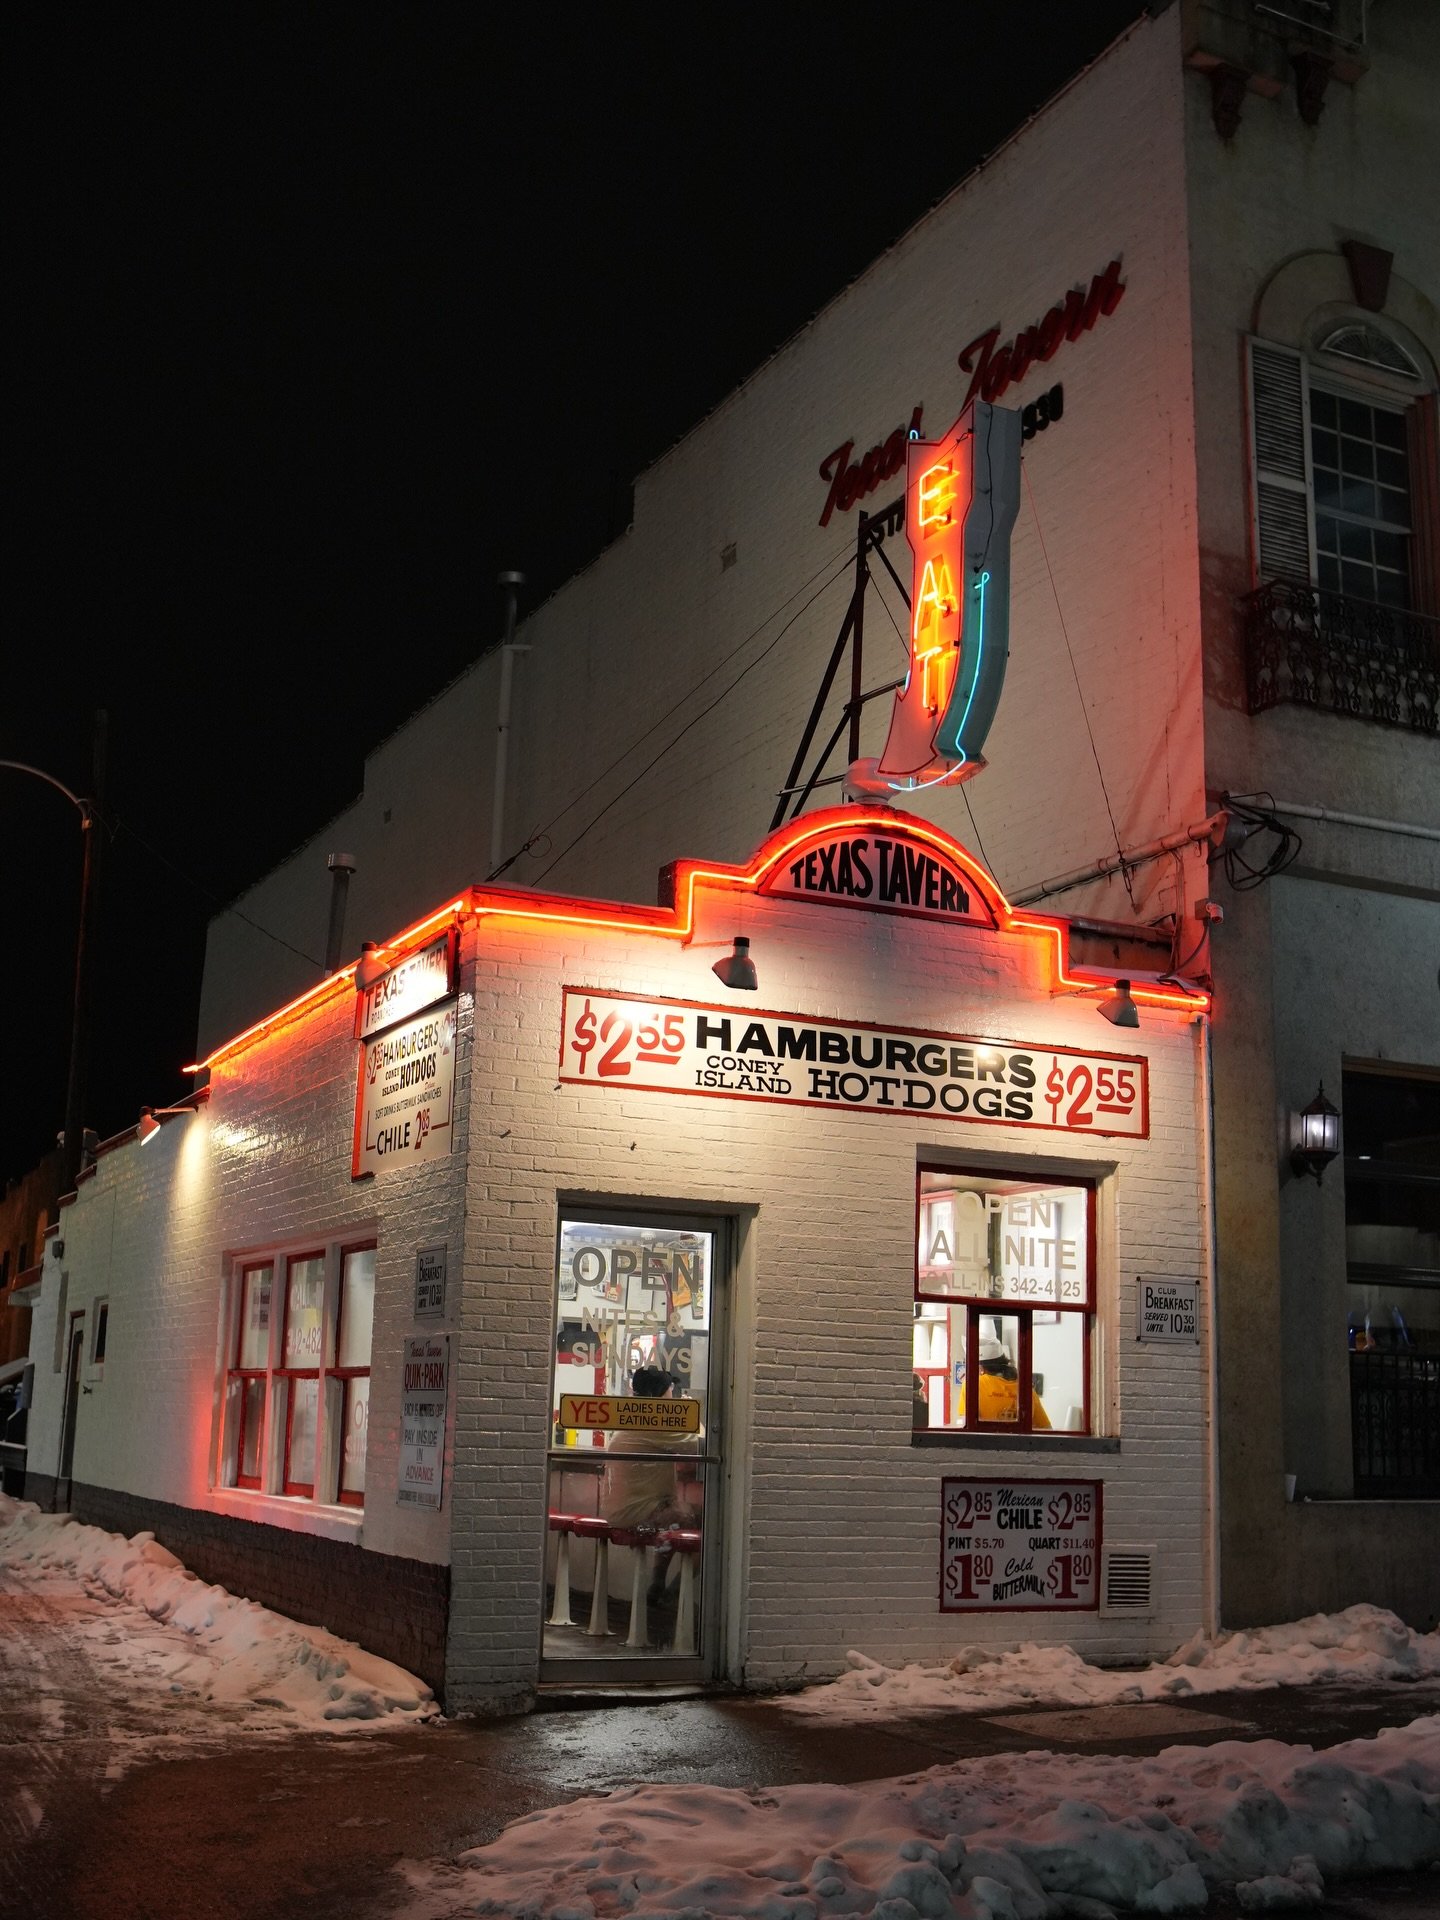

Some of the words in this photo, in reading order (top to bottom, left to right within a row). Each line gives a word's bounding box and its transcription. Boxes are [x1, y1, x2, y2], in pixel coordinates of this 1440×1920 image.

[913, 461, 960, 712] EAT
[790, 838, 873, 898] TEXAS
[875, 839, 970, 914] TAVERN
[365, 969, 405, 1028] TEXAS
[383, 1021, 439, 1068] HAMBURGERS
[696, 1015, 1036, 1089] HAMBURGERS
[400, 1053, 436, 1090] HOTDOGS
[706, 1055, 784, 1076] CONEY
[382, 1083, 400, 1097] ISLAND
[695, 1070, 792, 1095] ISLAND
[808, 1068, 1034, 1121] HOTDOGS
[377, 1122, 411, 1155] CHILE
[955, 1190, 1051, 1229] OPEN
[930, 1230, 990, 1263] ALL
[1005, 1235, 1077, 1270] NITE
[419, 1259, 443, 1282] BREAKFAST
[572, 1246, 700, 1295] OPEN
[1010, 1277, 1081, 1298] 342-4825
[1145, 1287, 1194, 1311] BREAKFAST
[1158, 1287, 1177, 1296] CLUB
[581, 1306, 658, 1336] NITES
[667, 1310, 685, 1338] &
[1144, 1312, 1169, 1322] SERVED
[1146, 1323, 1164, 1333] UNTIL
[1183, 1325, 1195, 1334] AM
[571, 1342, 693, 1373] SUNDAYS
[570, 1400, 610, 1424] YES
[616, 1402, 653, 1415] LADIES
[656, 1403, 690, 1416] ENJOY
[619, 1415, 658, 1427] EATING
[660, 1416, 687, 1428] HERE
[404, 1429, 415, 1444] PAY
[416, 1429, 438, 1446] INSIDE
[405, 1465, 434, 1482] ADVANCE
[997, 1488, 1043, 1507] Mexican
[997, 1508, 1043, 1530] CHILE
[948, 1537, 972, 1550] PINT
[974, 1538, 1005, 1550] $5.70
[1028, 1537, 1061, 1552] QUART
[1062, 1538, 1096, 1550] $11.40
[1004, 1556, 1034, 1577] Cold
[992, 1574, 1047, 1601] BUTTERMILK
